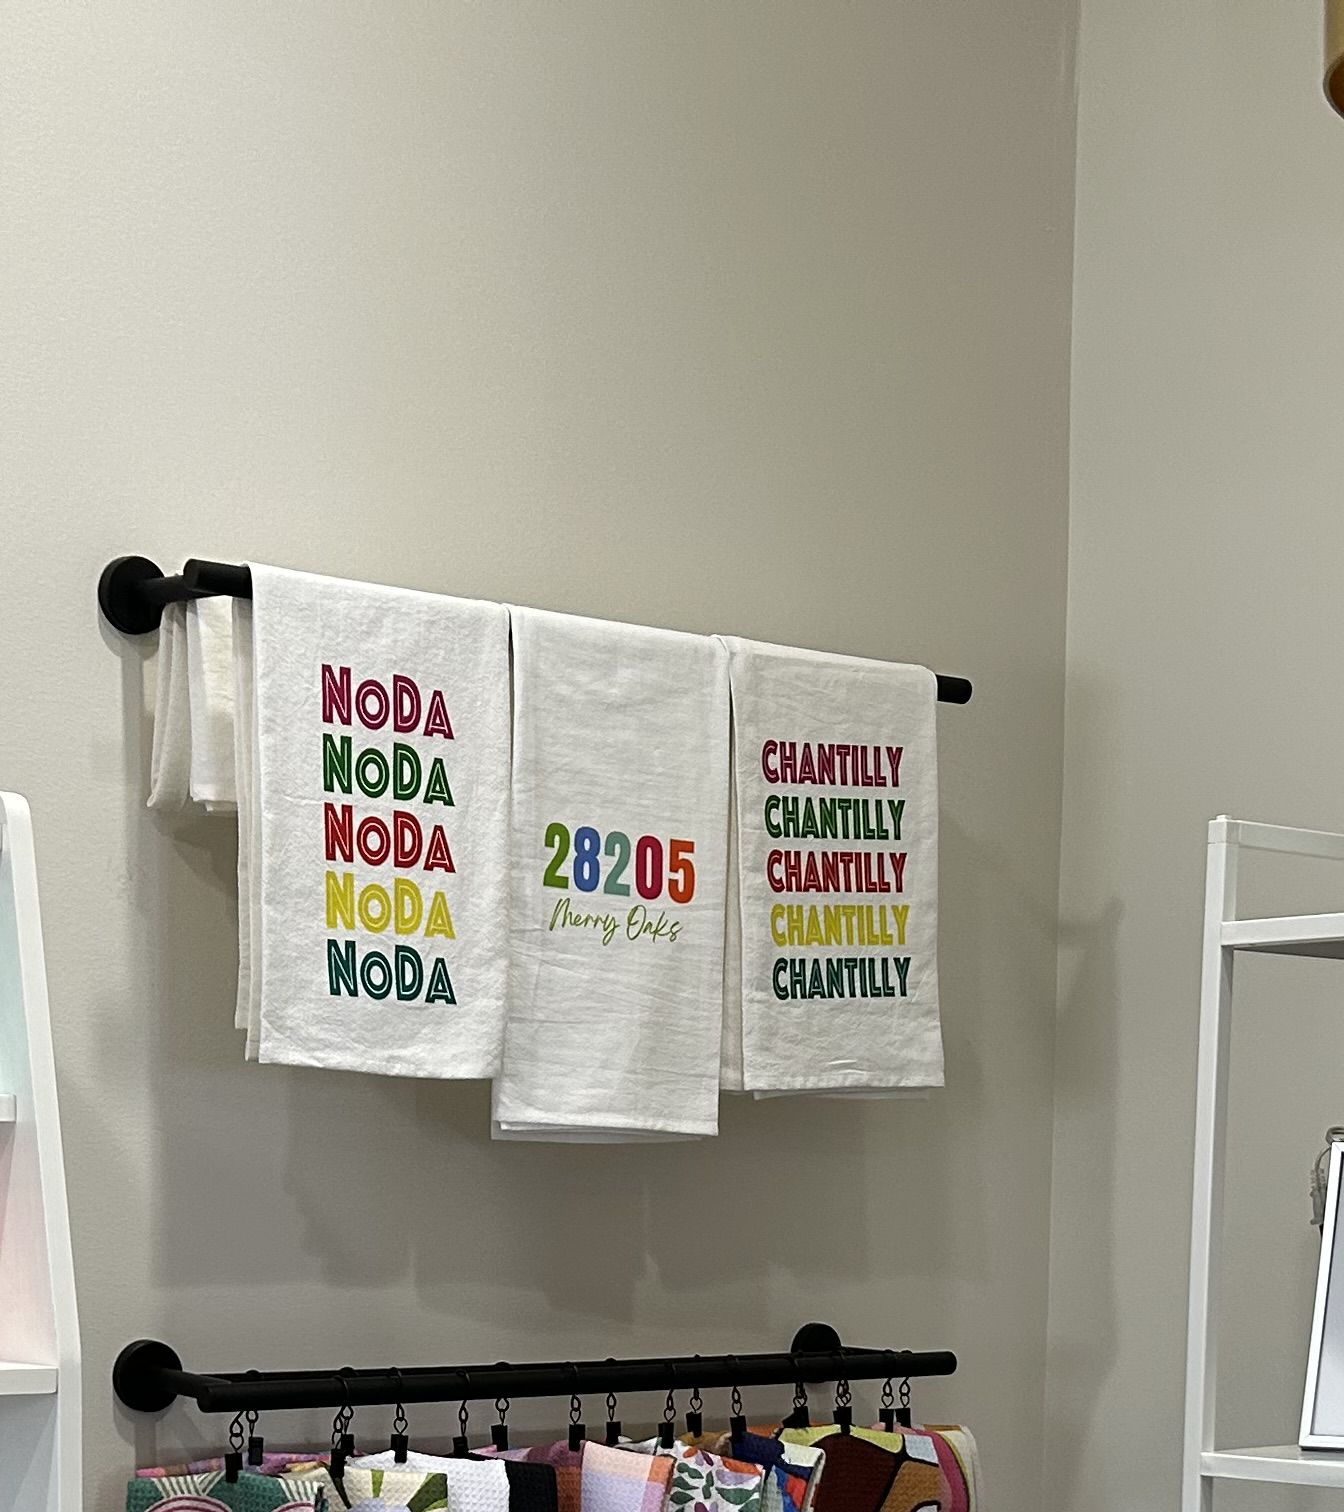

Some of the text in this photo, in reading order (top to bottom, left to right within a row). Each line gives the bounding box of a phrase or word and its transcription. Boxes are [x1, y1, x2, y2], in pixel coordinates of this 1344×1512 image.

[762, 740, 903, 787] CHANTILLY
[764, 794, 905, 840] CHANTILLY
[543, 822, 695, 904] 28205
[767, 849, 907, 893] CHANTILLY
[549, 898, 683, 946] Merry Oaks
[770, 903, 909, 947] CHANTILLY
[773, 957, 911, 1000] CHANTILLY
